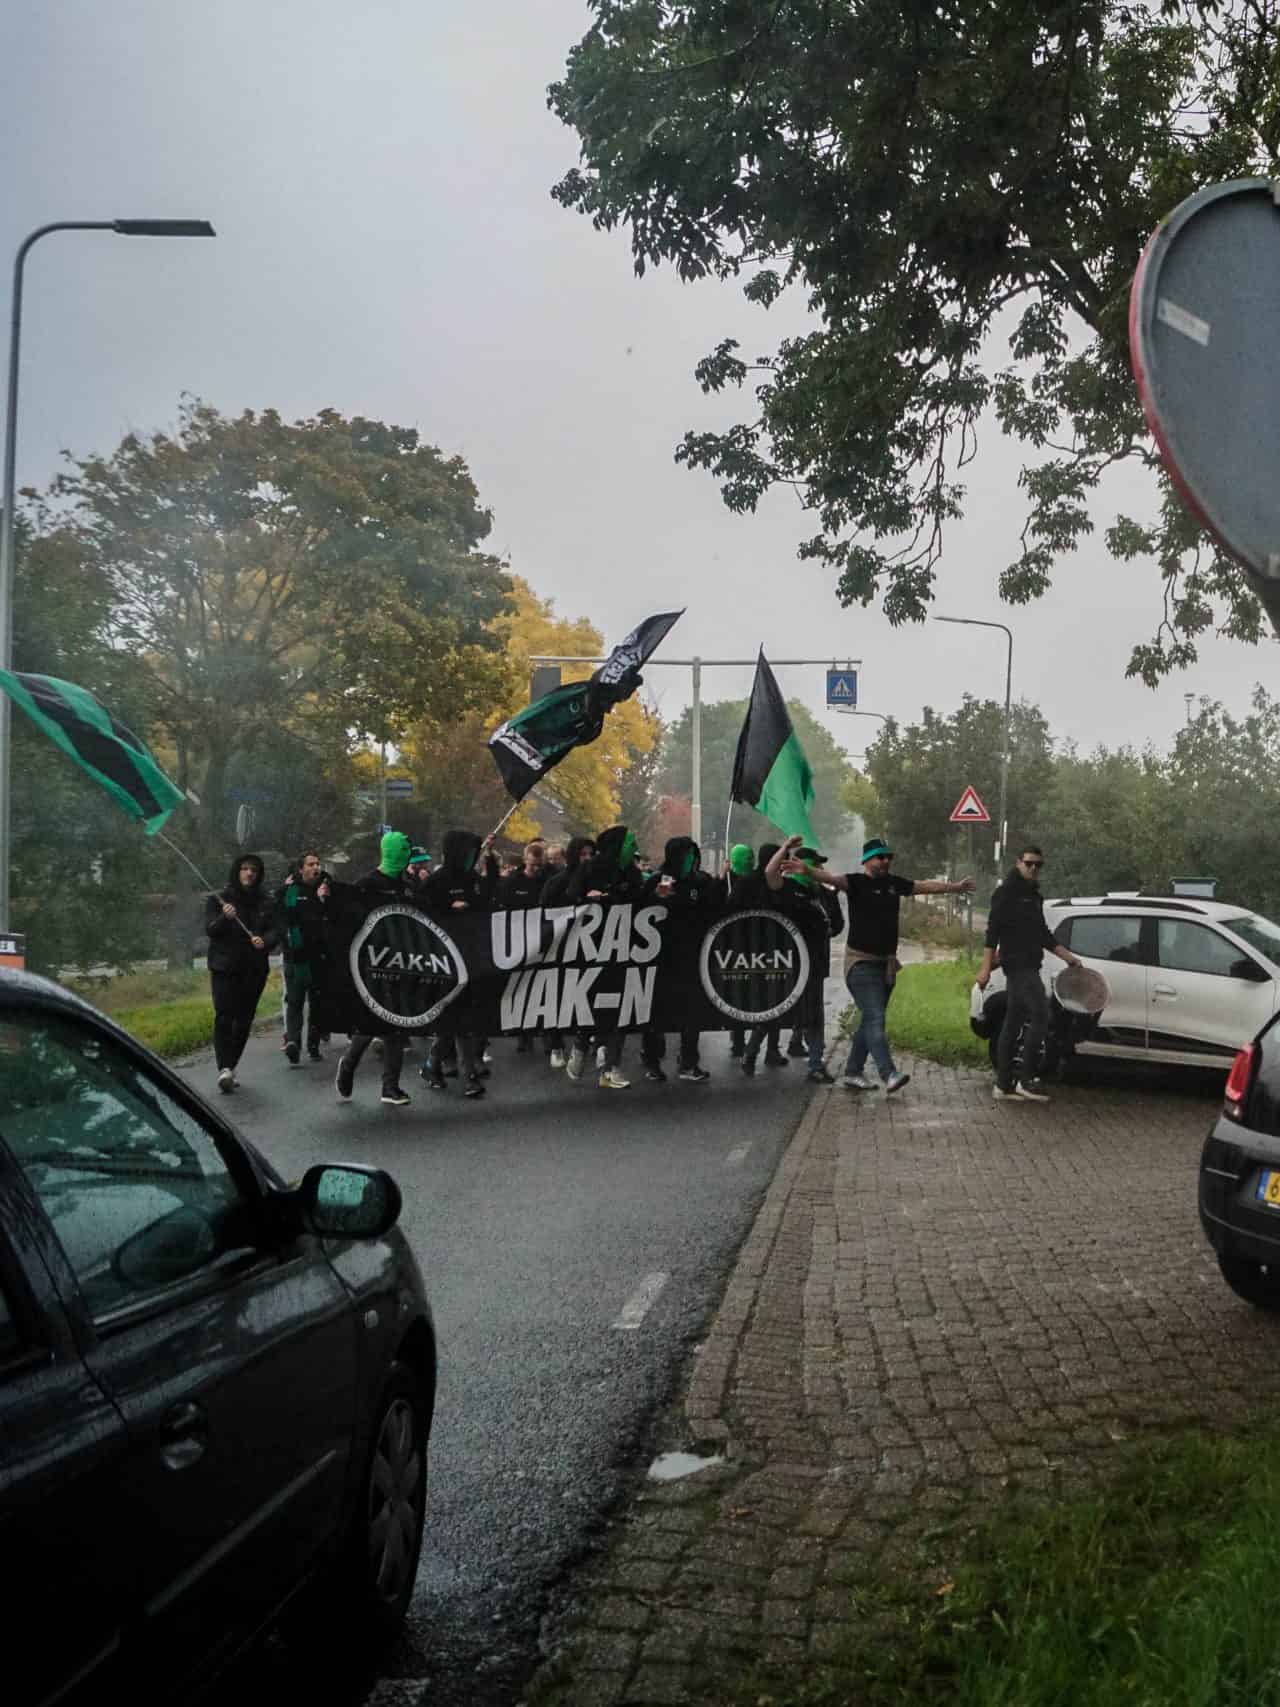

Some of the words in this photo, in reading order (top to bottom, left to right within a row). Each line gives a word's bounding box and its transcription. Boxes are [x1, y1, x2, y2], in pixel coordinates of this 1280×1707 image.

[367, 945, 451, 975] VAK-N
[491, 903, 668, 970] ULTRAS
[714, 949, 793, 969] VAK-N
[501, 966, 657, 1031] VAK-N
